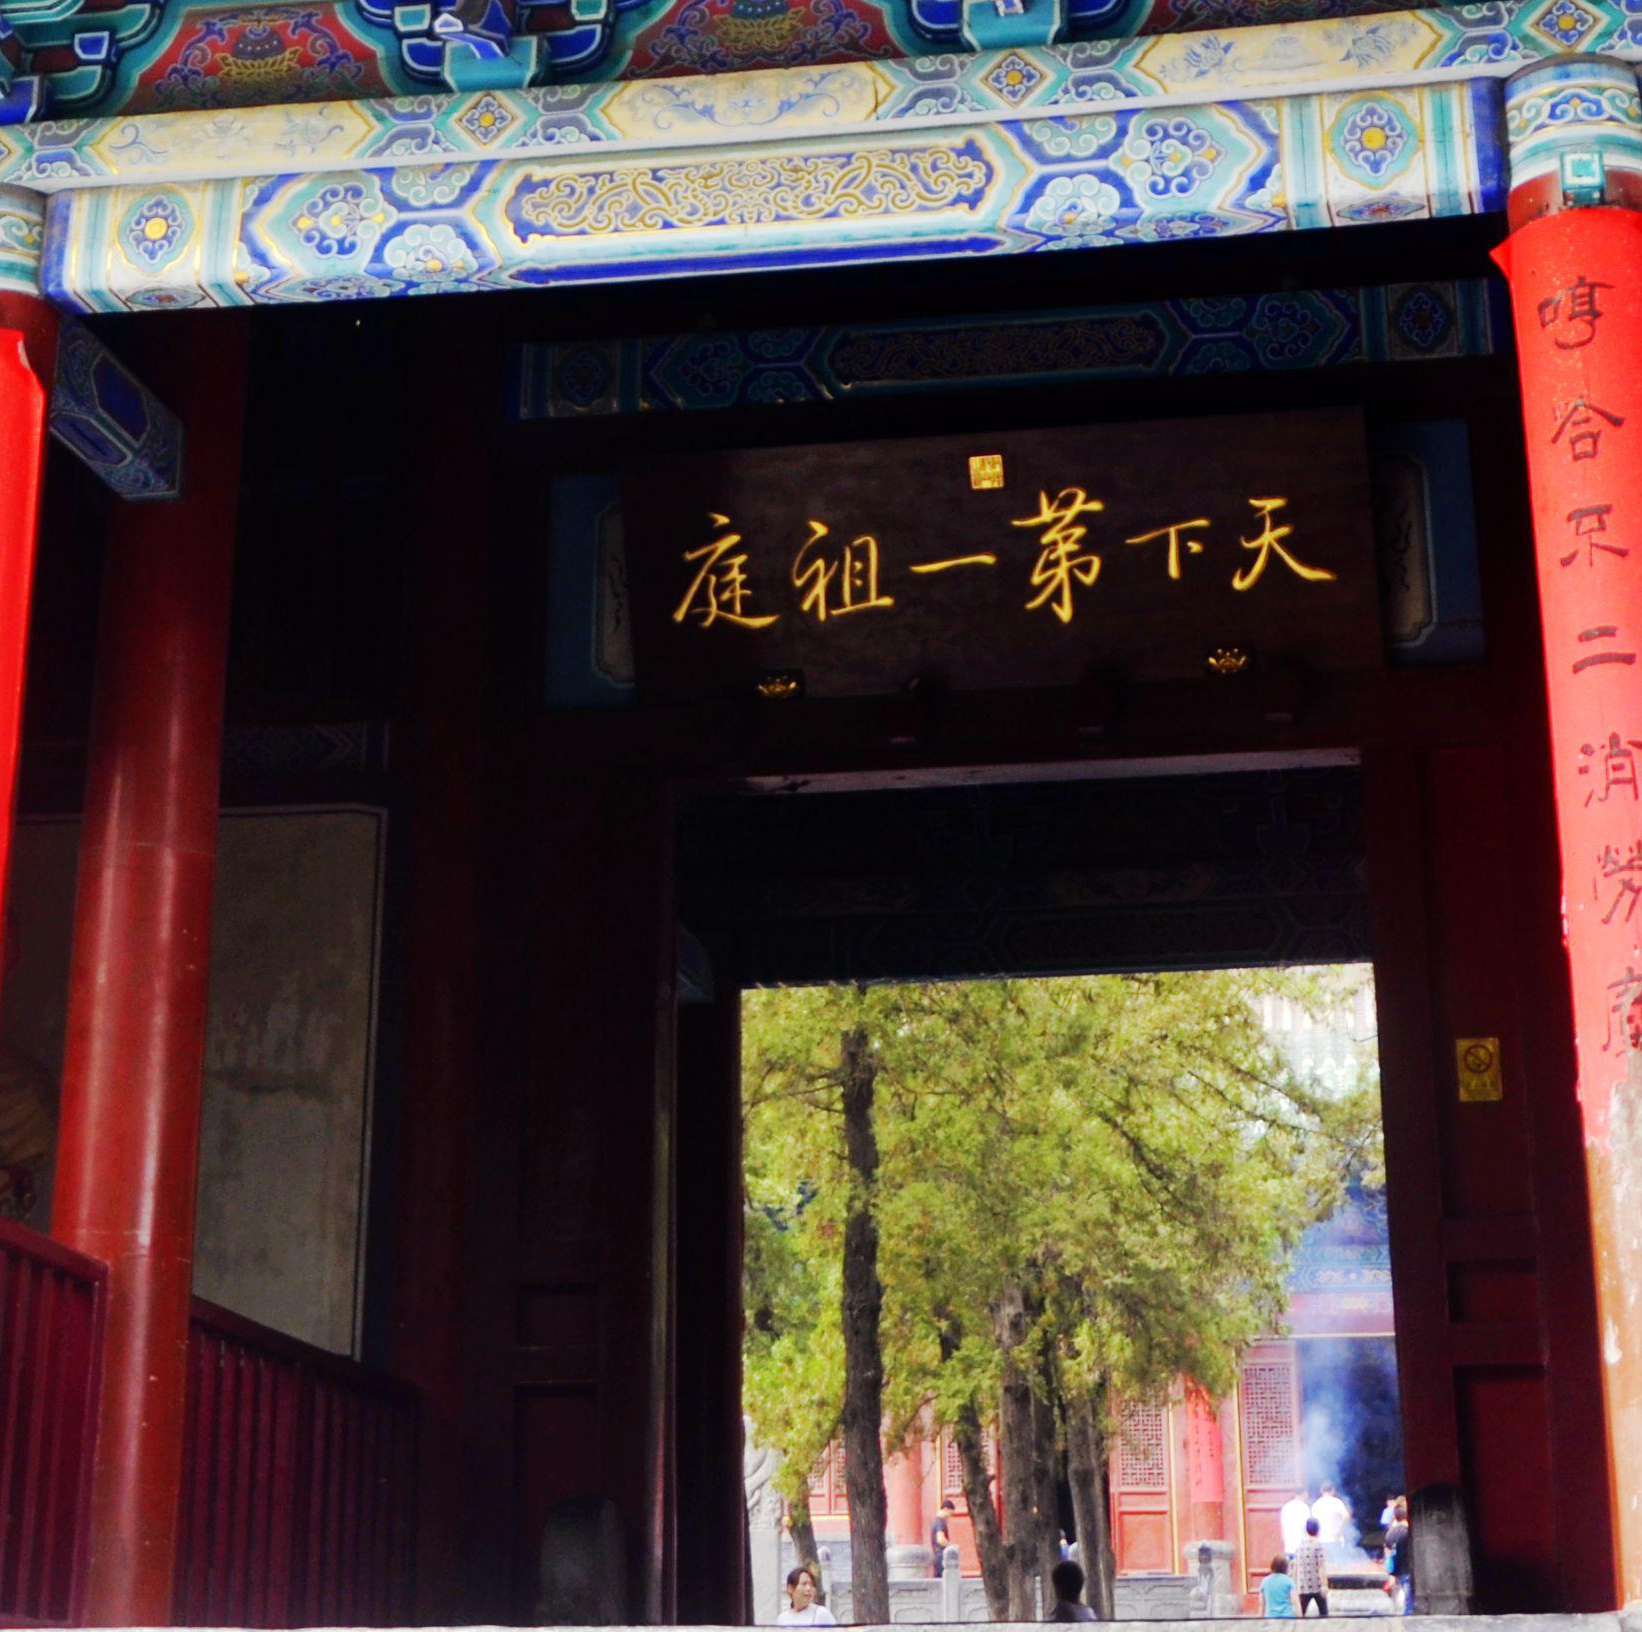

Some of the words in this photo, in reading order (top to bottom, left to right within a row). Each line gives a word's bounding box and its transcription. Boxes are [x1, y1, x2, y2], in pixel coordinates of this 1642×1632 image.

[672, 486, 1336, 630] 天下第一祖庭
